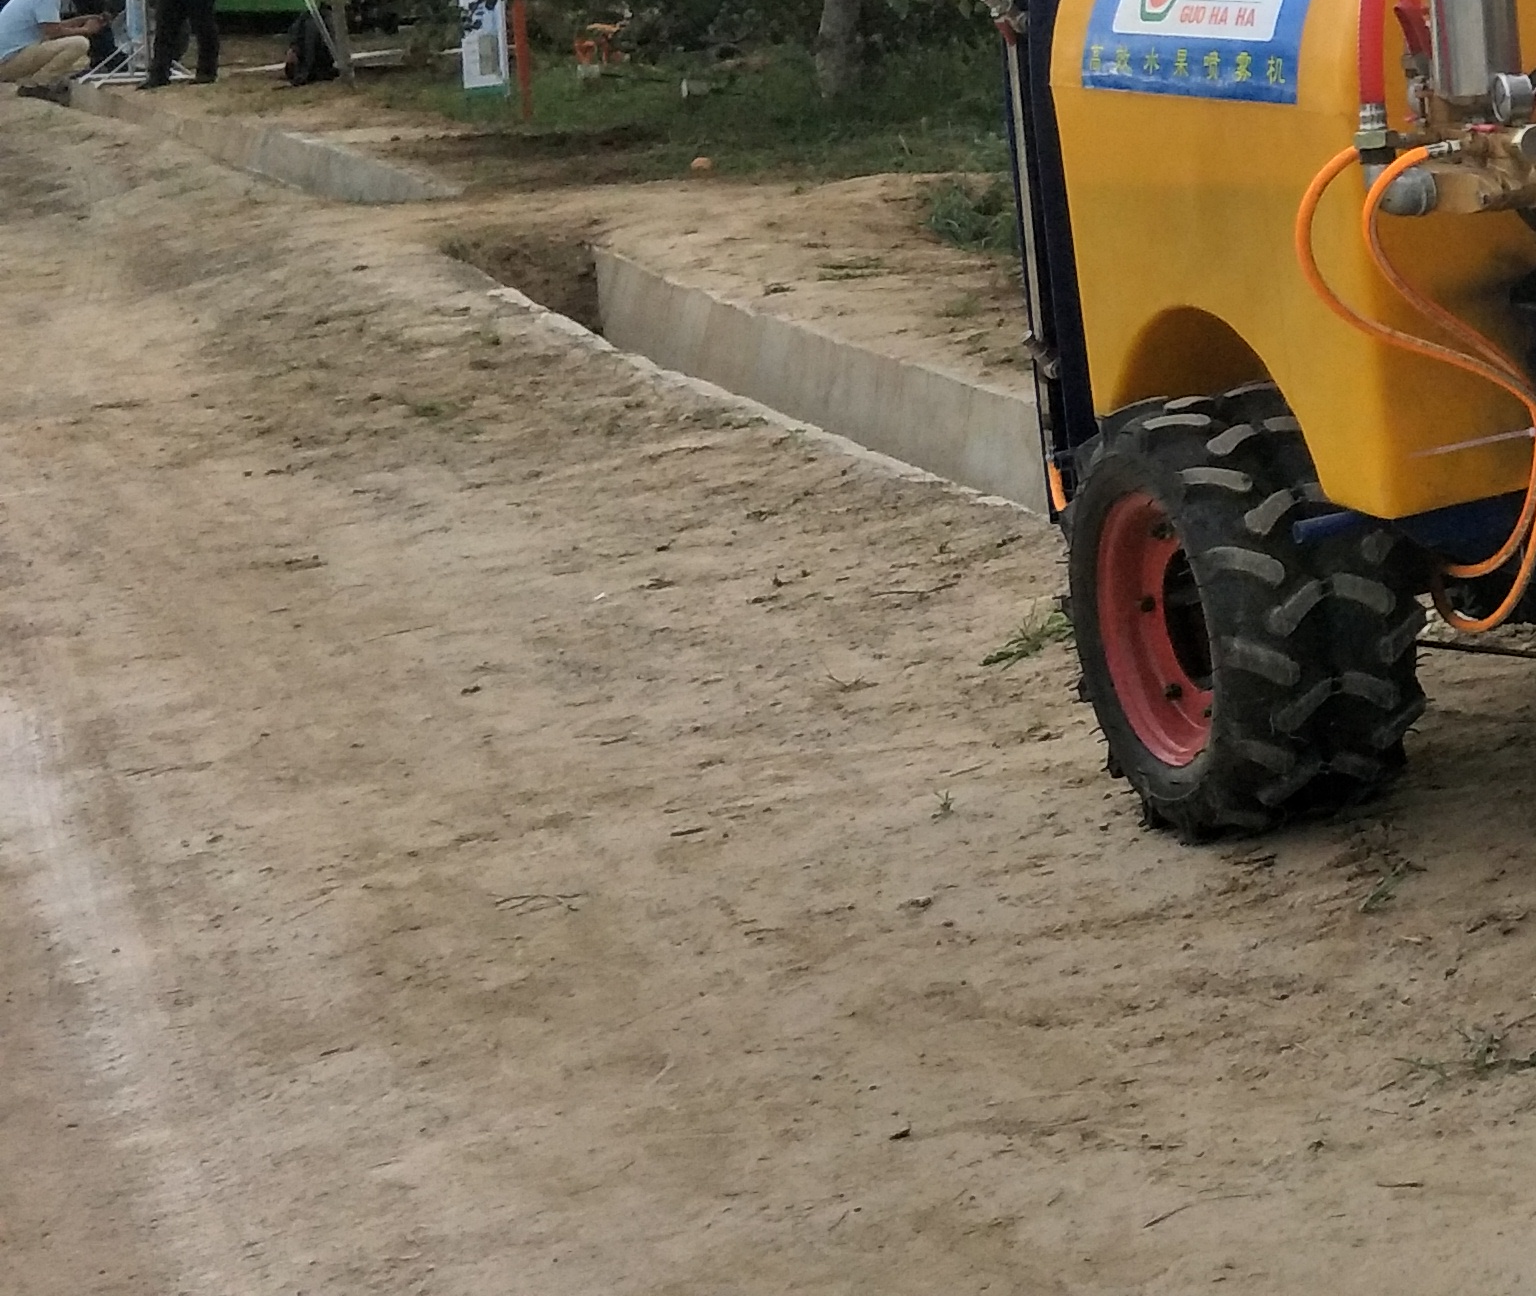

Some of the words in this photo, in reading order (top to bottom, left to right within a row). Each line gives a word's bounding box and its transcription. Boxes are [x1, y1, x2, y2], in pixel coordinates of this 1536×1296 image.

[1180, 6, 1206, 24] GUO
[1208, 6, 1229, 25] HA
[1235, 7, 1255, 27] HA
